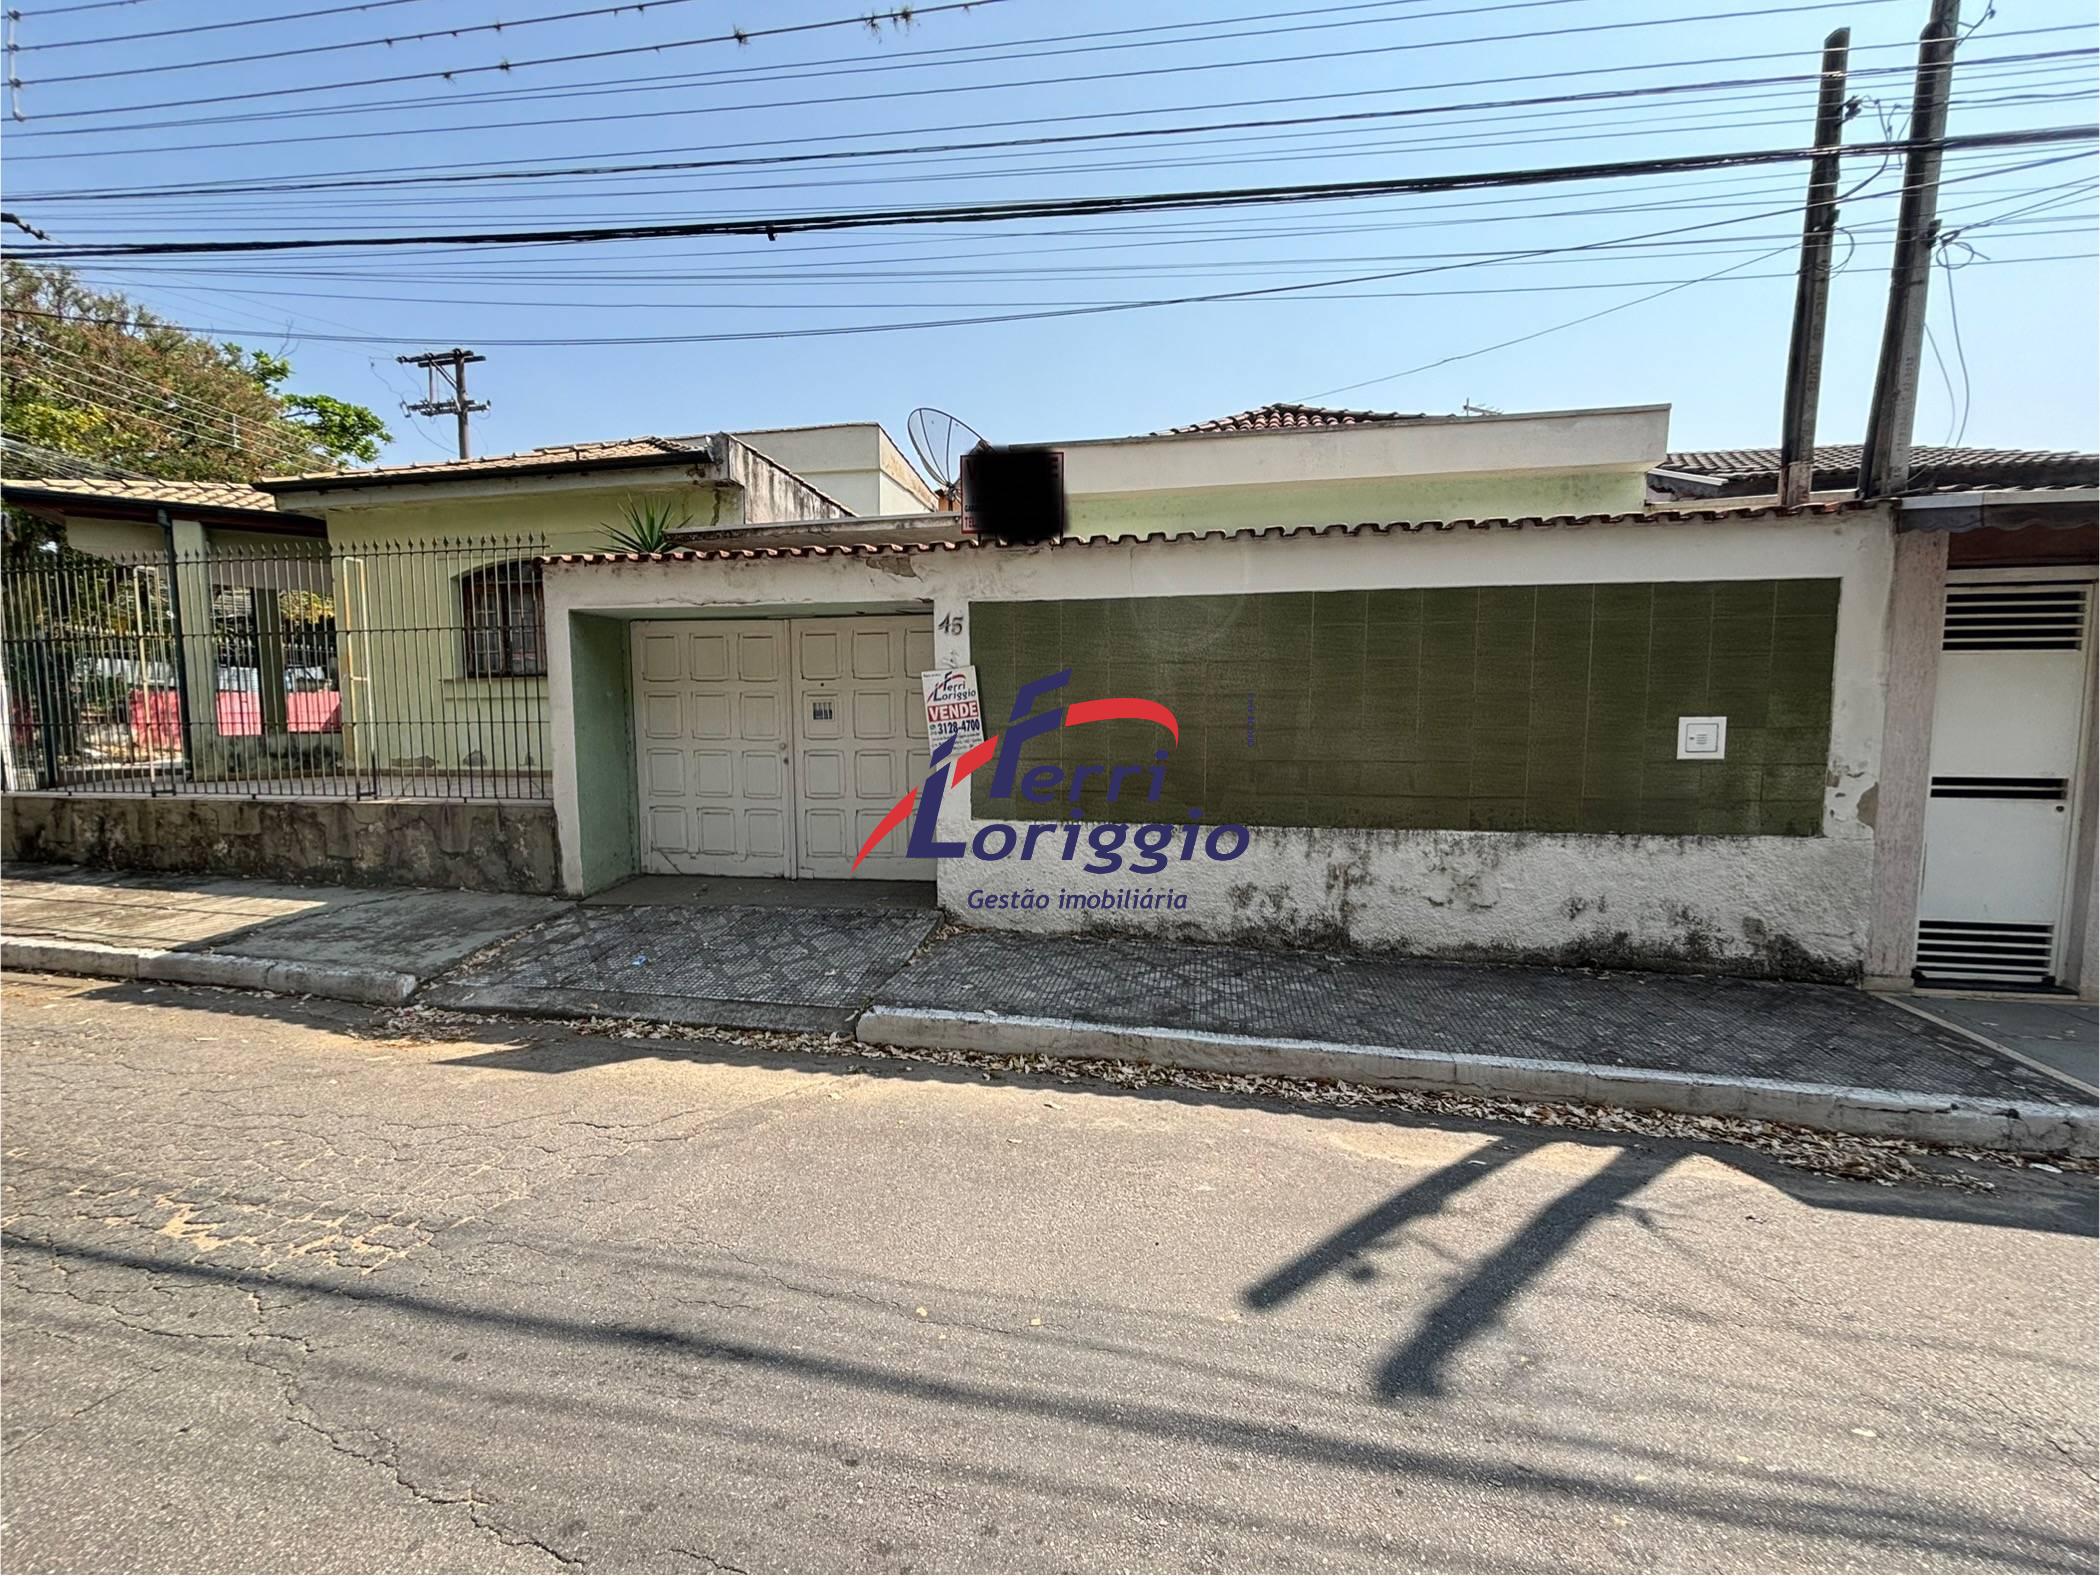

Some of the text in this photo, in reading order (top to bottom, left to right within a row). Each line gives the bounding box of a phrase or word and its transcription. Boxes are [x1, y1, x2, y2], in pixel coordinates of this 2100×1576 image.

[943, 671, 966, 691] Ferri
[933, 687, 977, 702] Loriggio
[929, 702, 978, 721] VENDE
[937, 719, 980, 735] 3128-4700
